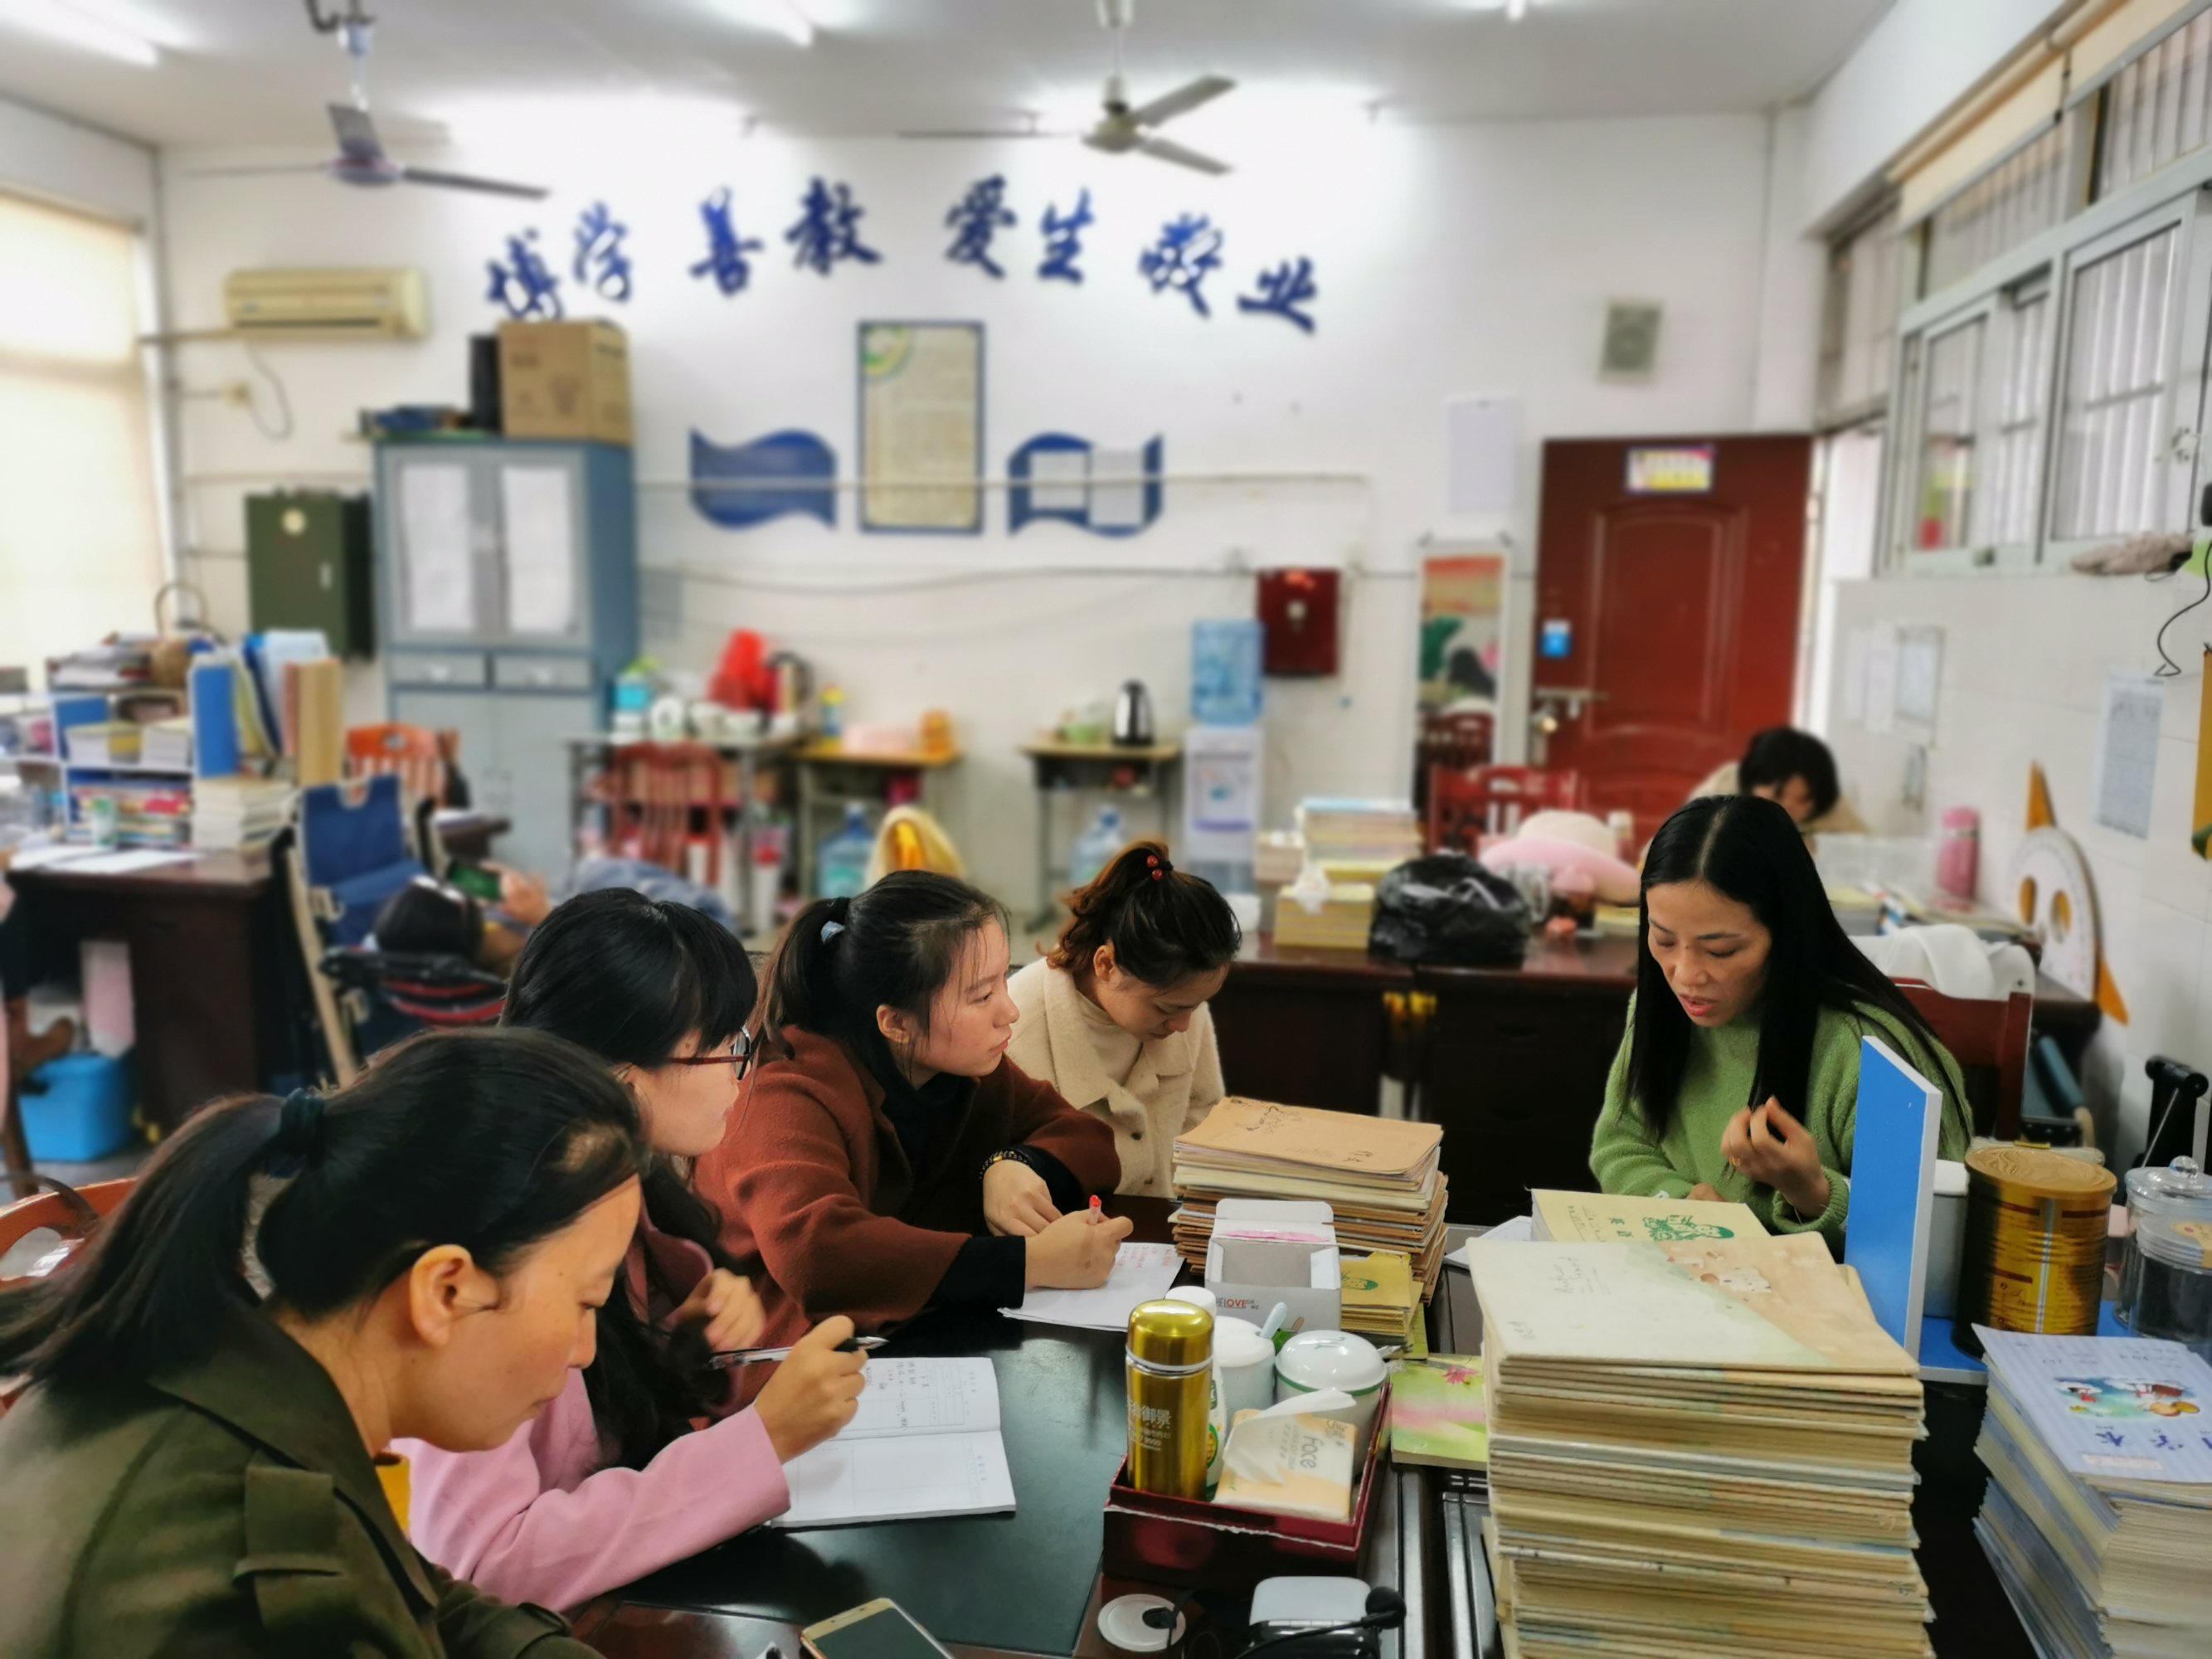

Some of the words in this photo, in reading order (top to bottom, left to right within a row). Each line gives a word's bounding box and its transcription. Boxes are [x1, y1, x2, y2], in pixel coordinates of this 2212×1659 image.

[688, 175, 882, 299] 善教
[944, 173, 1096, 285] 爱生
[1138, 211, 1320, 335] 敬业
[1300, 1435, 1325, 1469] Face
